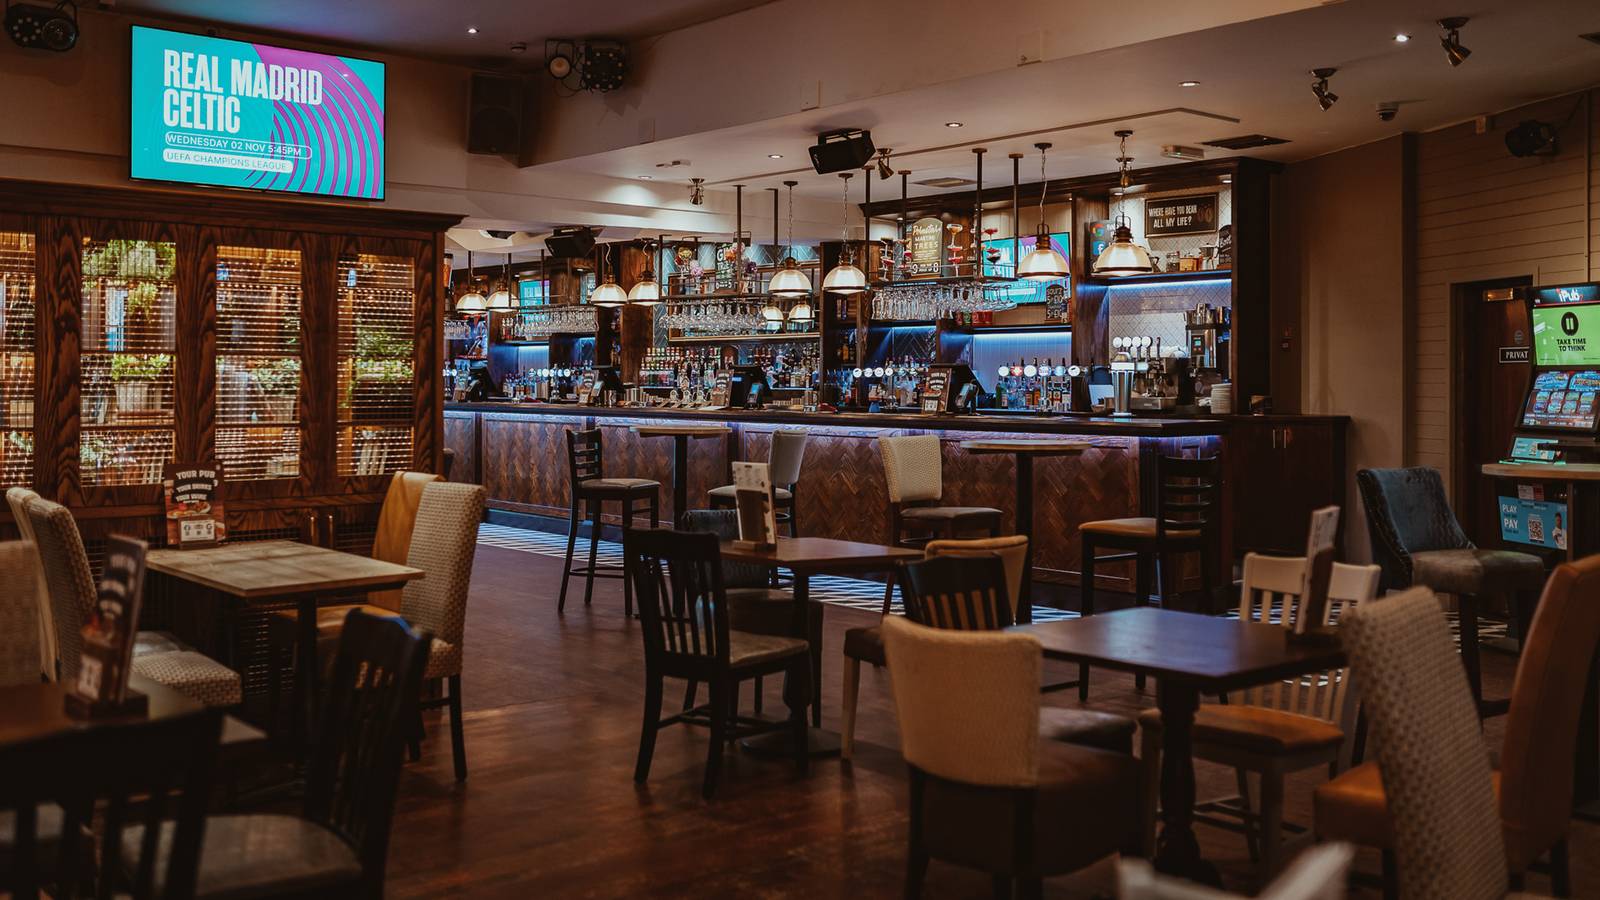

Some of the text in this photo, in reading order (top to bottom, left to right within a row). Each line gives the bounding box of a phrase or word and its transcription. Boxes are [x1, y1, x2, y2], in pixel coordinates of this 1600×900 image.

[164, 49, 323, 105] REAL MADRID
[164, 89, 240, 133] CELTIC
[167, 134, 302, 156] WEDNESDAY 02 NOV 5:45PM
[167, 152, 286, 170] UEFA CHAMPIONS LEAGUE
[1149, 207, 1164, 217] WHERE
[1165, 207, 1176, 216] HAVE
[1153, 216, 1192, 229] ALL MY LIFE?
[1505, 350, 1529, 359] PRIVAT
[176, 470, 216, 479] YOUR PUB
[1503, 504, 1517, 513] PLAY
[1504, 518, 1518, 528] PAY
